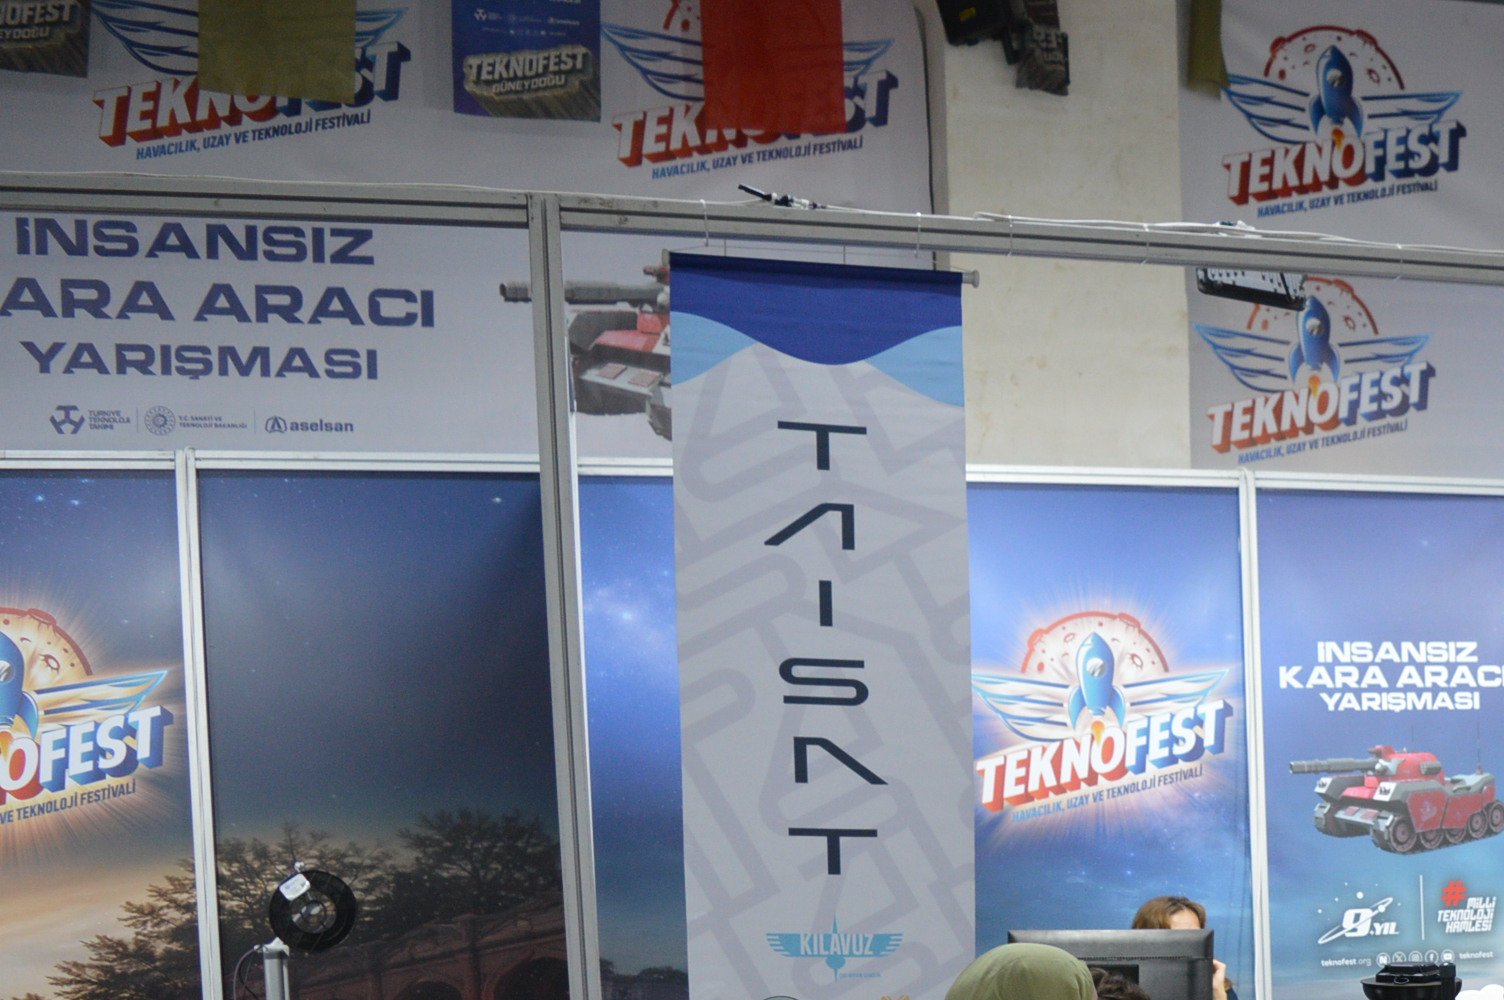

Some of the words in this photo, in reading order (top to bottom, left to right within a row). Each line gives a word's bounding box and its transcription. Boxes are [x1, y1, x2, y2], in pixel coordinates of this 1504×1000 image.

[234, 130, 249, 145] VE
[741, 152, 754, 166] VE
[1222, 119, 1467, 206] TEKNOFEST
[0, 277, 176, 322] ARA
[193, 282, 435, 328] ARACI
[19, 341, 379, 381] YARIŞMASI
[1206, 361, 1437, 454] TEKNOFEST
[289, 418, 355, 434] aselsan
[1279, 664, 1389, 690] KARA
[1318, 691, 1481, 713] YARIŞMASI
[976, 699, 1234, 812] TEKNOFEST
[17, 792, 78, 820] TEKNOLOJİ
[80, 779, 137, 805] FESTİVALİ
[800, 932, 875, 957] KILAVUZ
[1320, 956, 1372, 967] teknofest.org
[1458, 950, 1494, 961] teknofest
